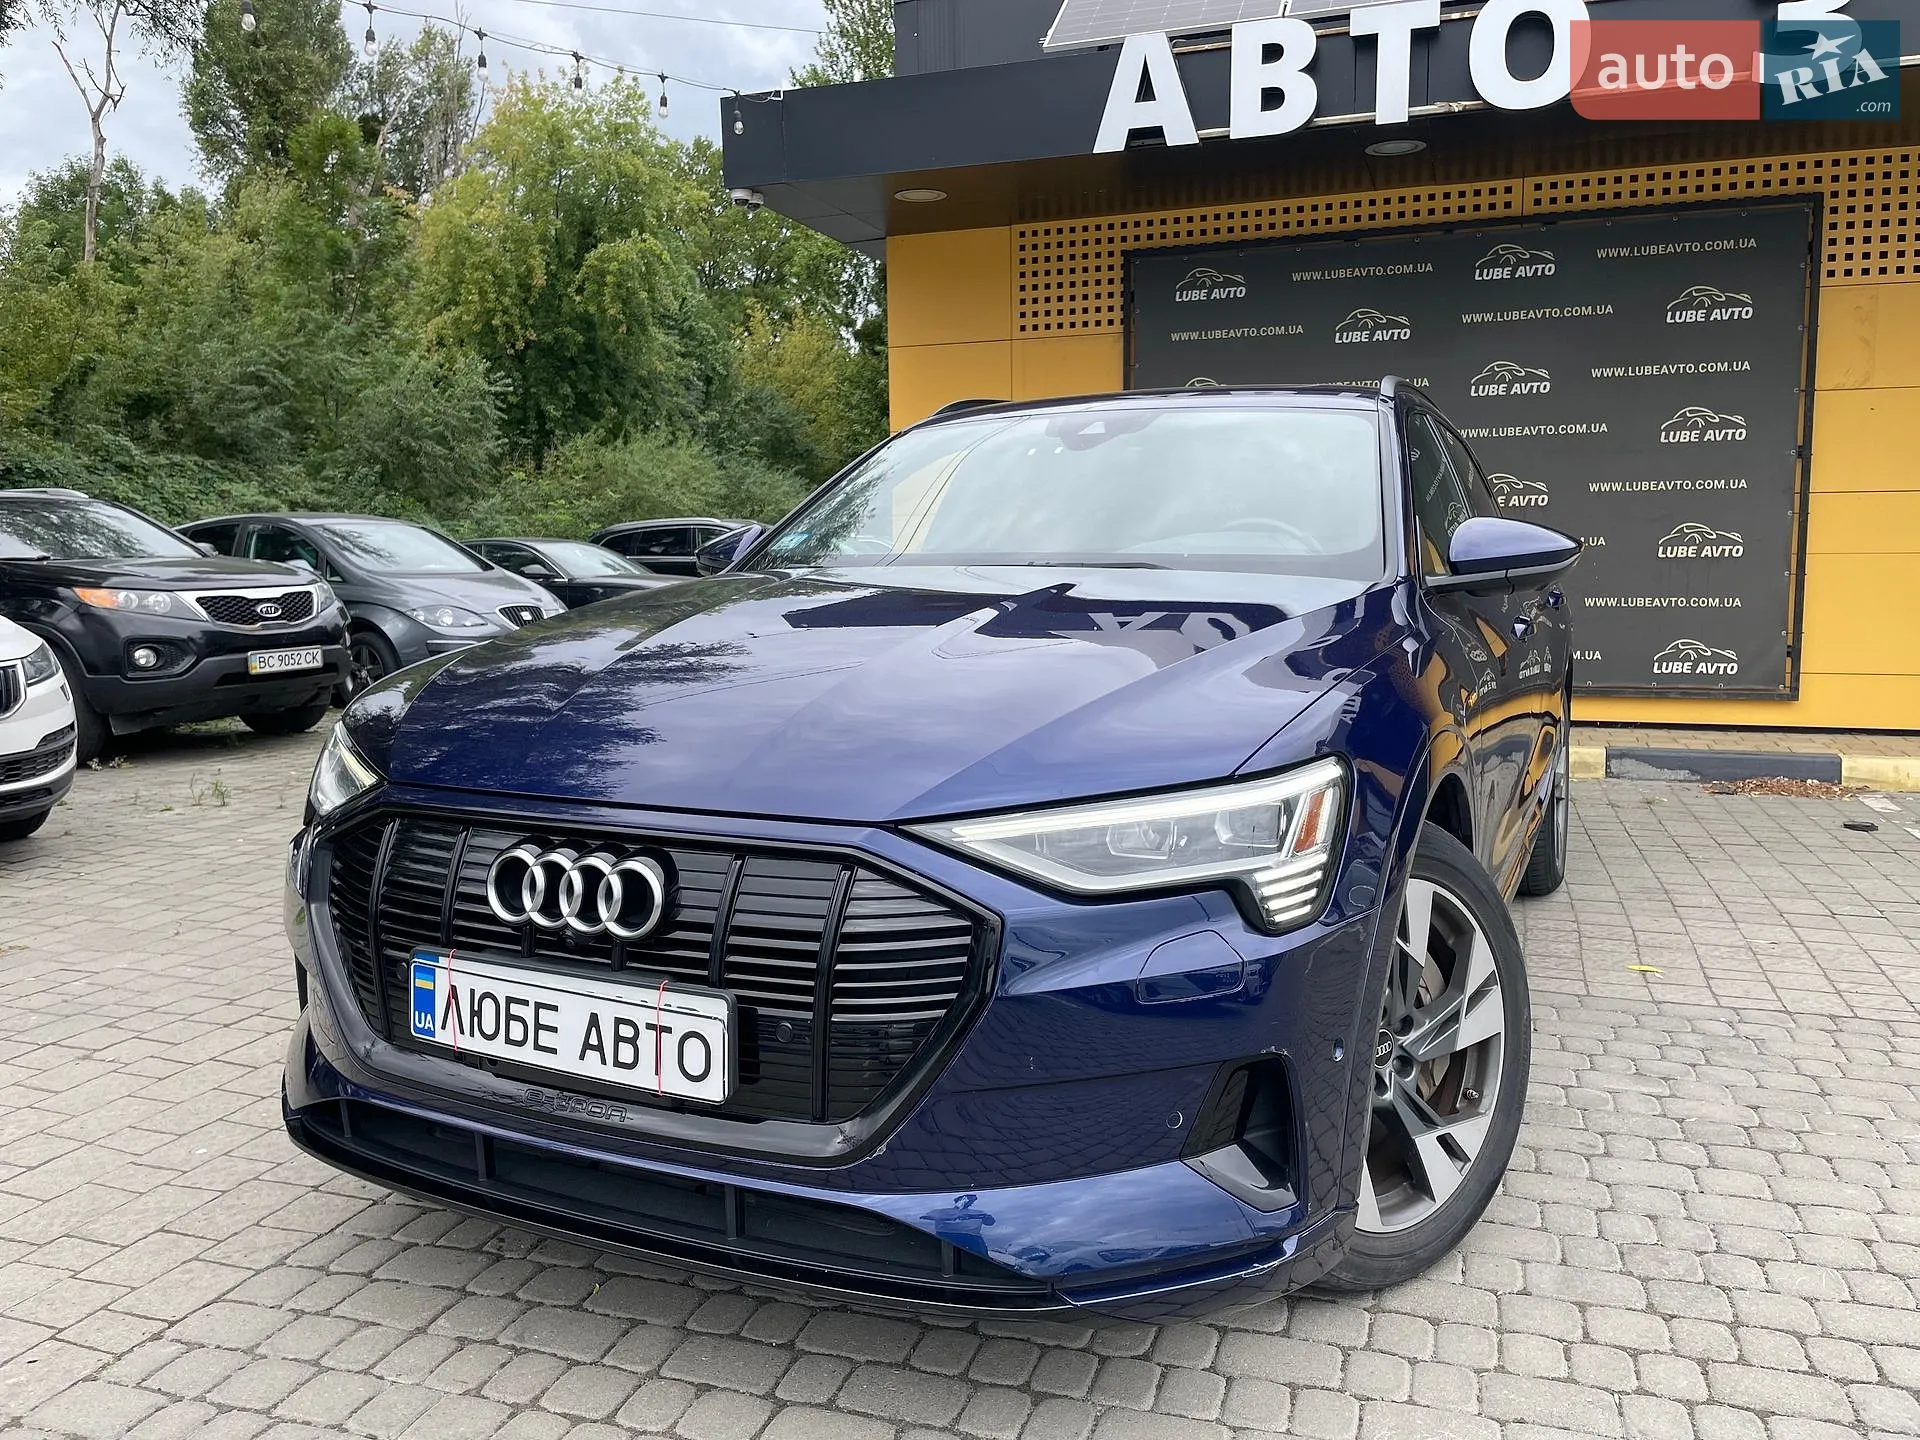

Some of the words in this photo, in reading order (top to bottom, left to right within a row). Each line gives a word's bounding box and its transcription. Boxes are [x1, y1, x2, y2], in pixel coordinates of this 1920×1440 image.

[1092, 0, 1592, 154] АВТО
[1596, 238, 1758, 259] WWW.LUBEAVTO.COM.UA
[1291, 263, 1434, 282] WWW.LUBEAVTO.COM.UA
[1474, 264, 1512, 281] LUBE
[1514, 262, 1556, 279] AVTO
[1175, 288, 1208, 302] LUBE
[1210, 285, 1246, 300] AVTO
[1461, 304, 1614, 324] WWW.LUBEAVTO.COM.UA
[1665, 307, 1706, 324] LUBE
[1709, 305, 1754, 322] AVTO
[1170, 324, 1304, 342] WWW.LUBEAVTO.COM.UA
[1334, 329, 1370, 344] LUBE
[1372, 327, 1411, 342] AVTO
[1591, 360, 1751, 379] WWW.LUBEAVTO.COM.UA
[1470, 383, 1507, 398] LUBE
[1510, 381, 1551, 396] AVTO
[1659, 428, 1700, 444] LUBE
[1703, 427, 1747, 443] AVTO
[1588, 478, 1748, 493] WWW.LUBEAVTO.COM.UA
[1508, 494, 1549, 507] AVTO
[1657, 544, 1697, 559] LUBE
[1700, 544, 1744, 558] AVTO
[1584, 596, 1742, 609] WWW.LUBEAVTO.COM.UA
[258, 655, 275, 670] BC
[277, 652, 302, 667] 9052
[304, 650, 320, 665] CK
[1653, 661, 1693, 675] LUBE
[1695, 661, 1739, 676] AVTO
[413, 1009, 435, 1032] UA
[440, 984, 560, 1055] ЛЮБЕ
[578, 1011, 712, 1083] АВТО
[523, 1088, 629, 1123] e-tron
